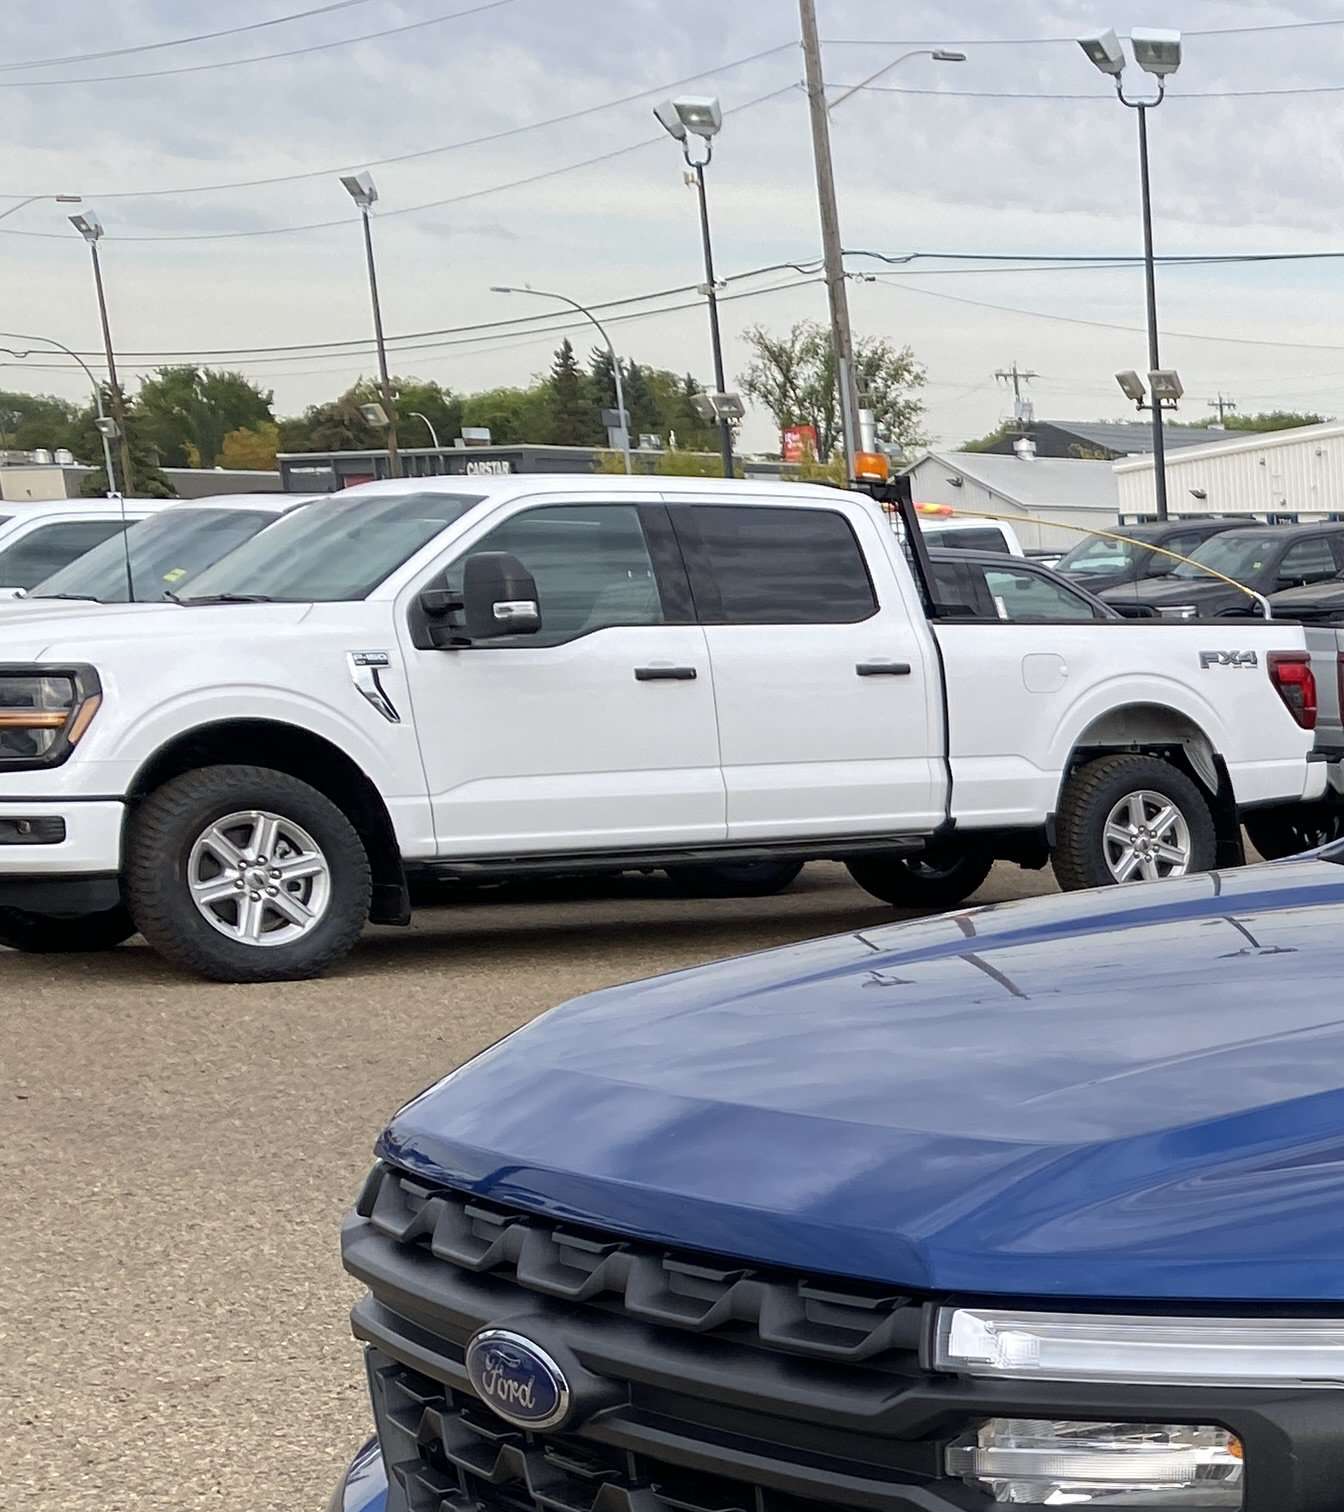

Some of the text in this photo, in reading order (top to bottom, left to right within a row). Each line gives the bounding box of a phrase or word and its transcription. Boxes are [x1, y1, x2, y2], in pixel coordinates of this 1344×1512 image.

[466, 460, 511, 475] CARSTAR
[1199, 650, 1258, 669] FX4
[482, 1349, 536, 1409] Ford
